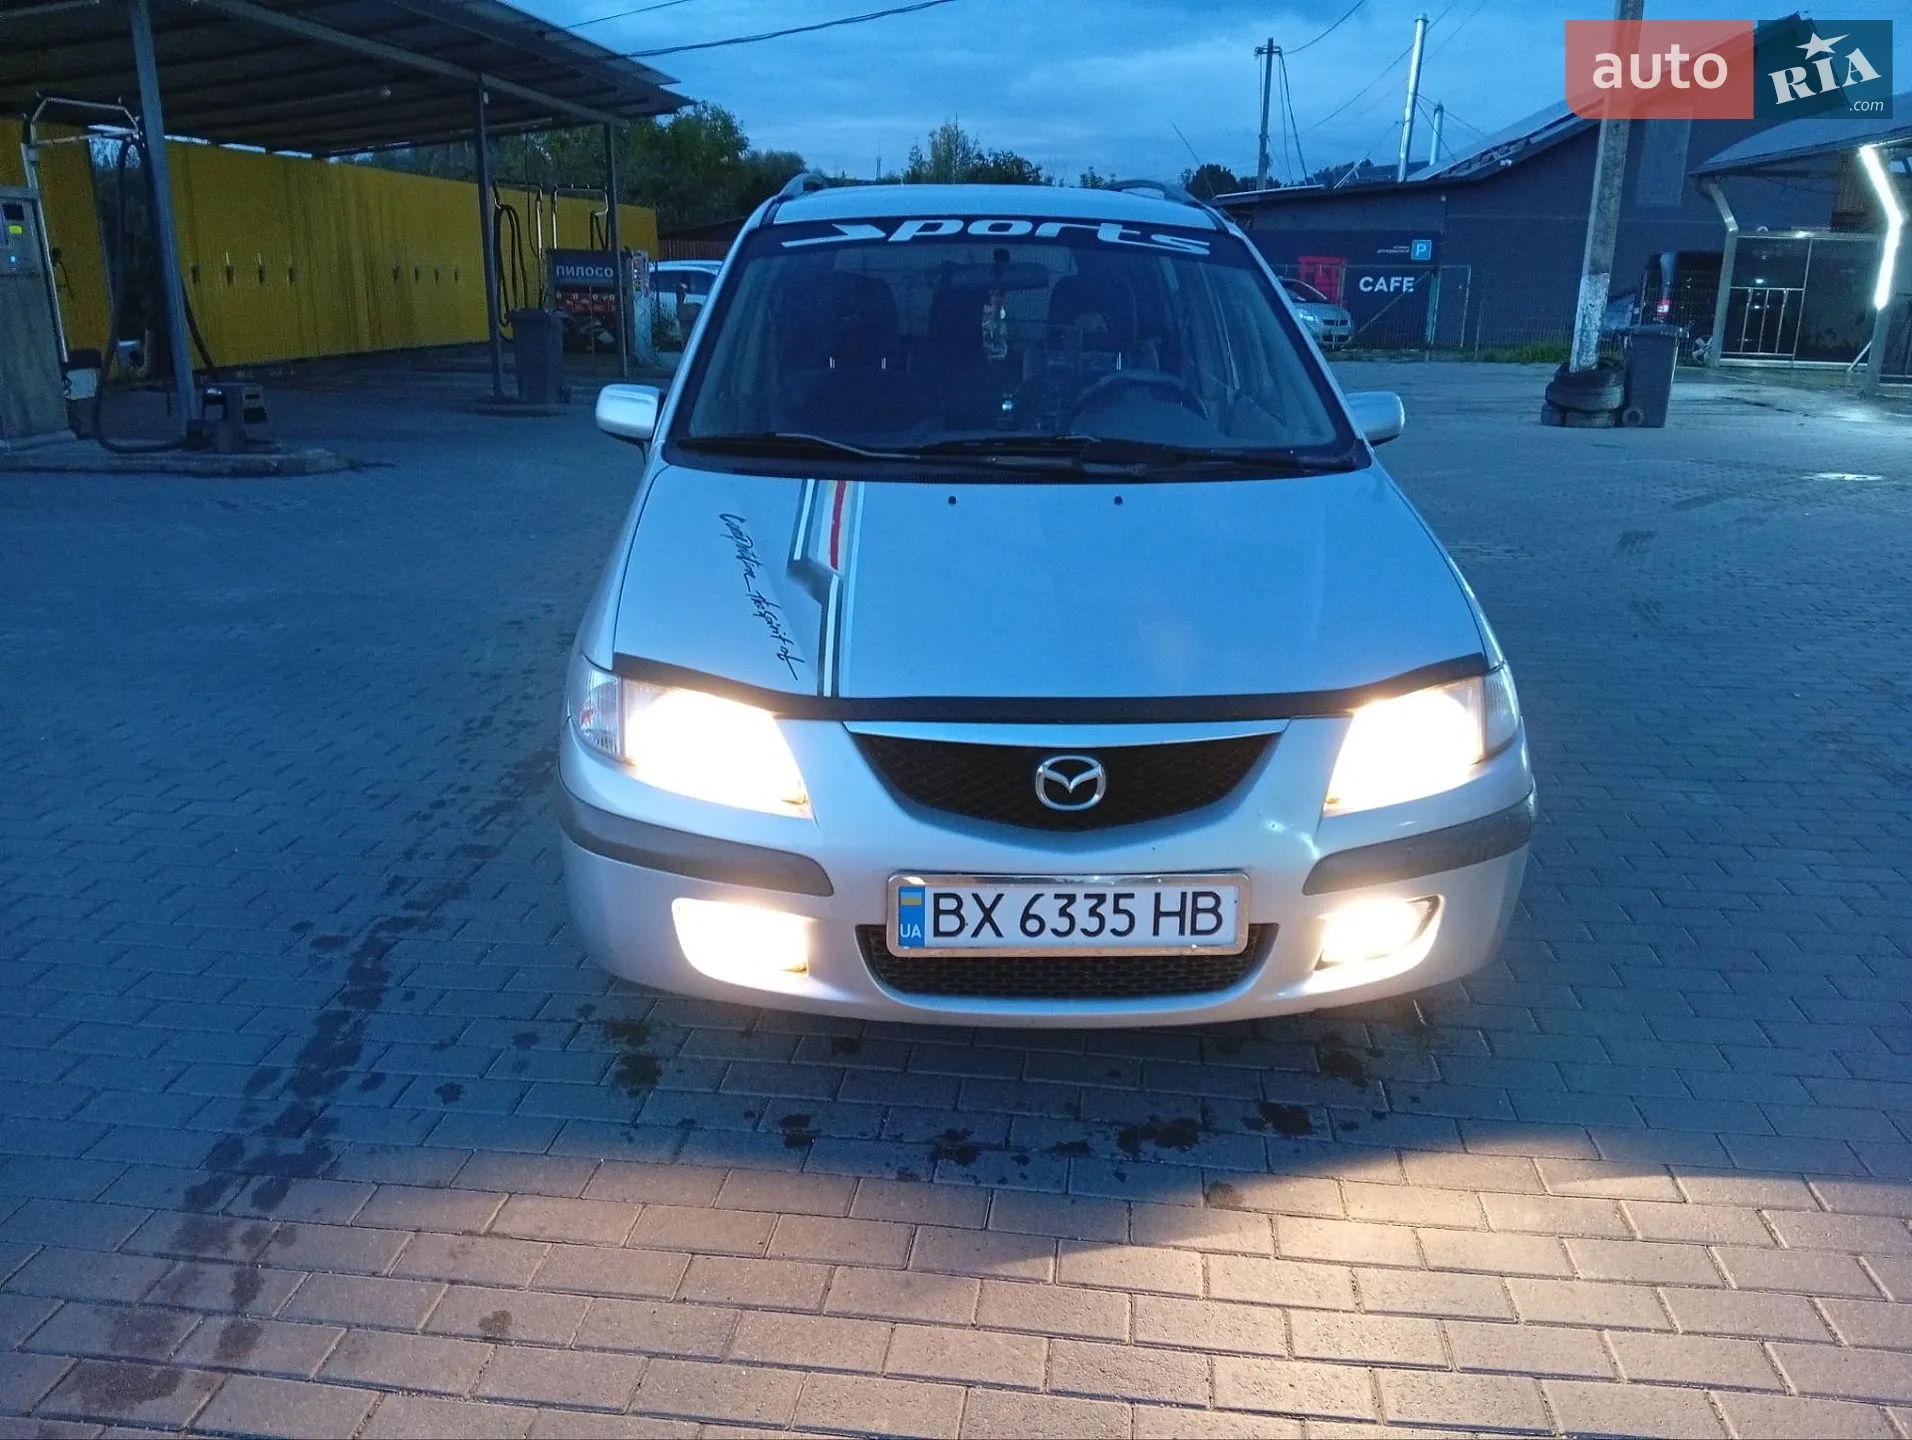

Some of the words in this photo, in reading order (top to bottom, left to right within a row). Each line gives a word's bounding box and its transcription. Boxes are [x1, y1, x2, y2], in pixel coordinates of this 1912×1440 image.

[1415, 243, 1428, 257] P
[555, 264, 615, 278] ПИЛОСО
[1358, 276, 1415, 293] CAFE
[933, 892, 1005, 938] BX
[1019, 892, 1136, 938] 6335
[1152, 891, 1224, 937] HB
[900, 923, 922, 939] UA
